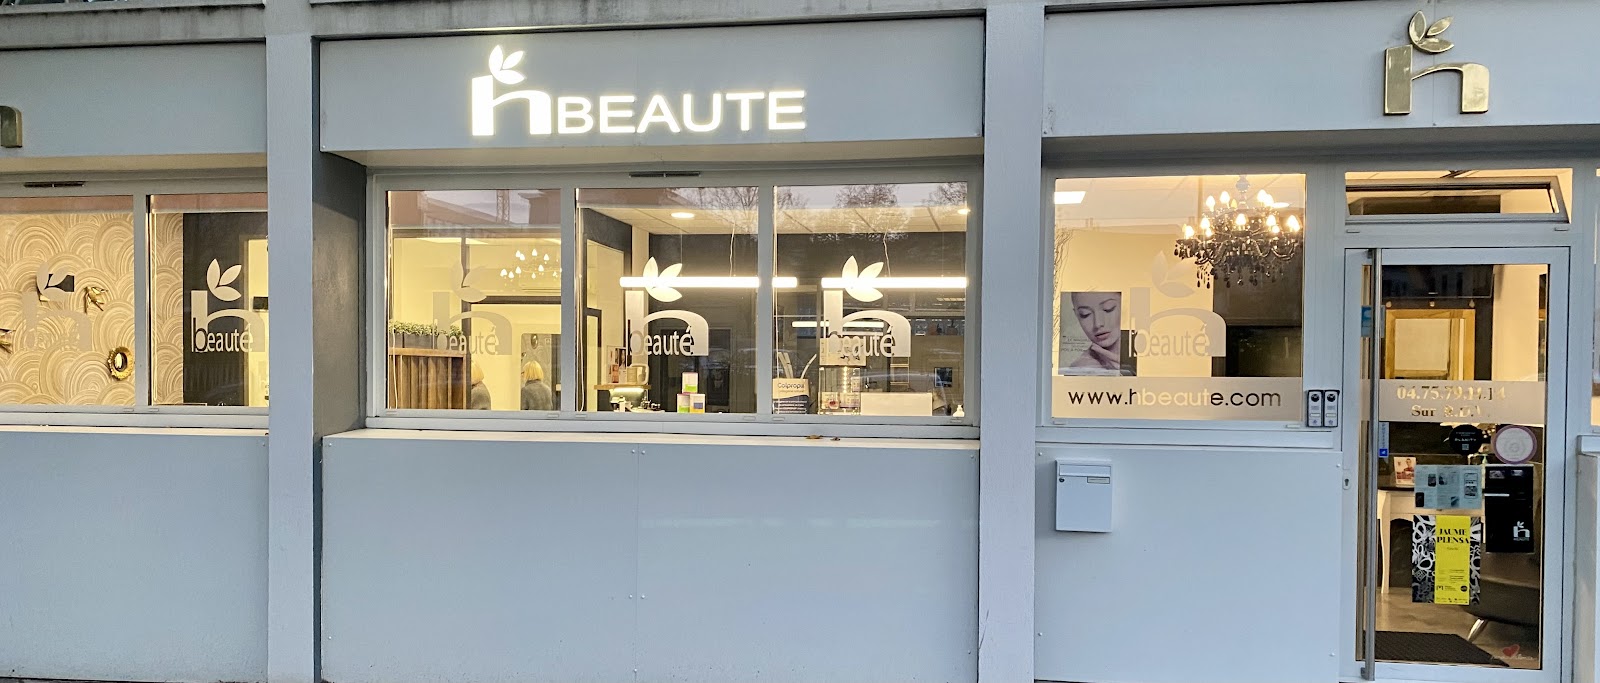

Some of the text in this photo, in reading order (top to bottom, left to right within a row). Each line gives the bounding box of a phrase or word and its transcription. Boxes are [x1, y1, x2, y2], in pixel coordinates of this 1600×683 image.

[193, 317, 254, 353] beauté
[627, 319, 695, 356] beauté
[1130, 317, 1210, 357] beauté
[1068, 387, 1281, 407] www.hbeaute.com
[1411, 404, 1437, 417] Sur
[1436, 536, 1470, 544] PLENSA
[1439, 528, 1467, 536] JAUME
